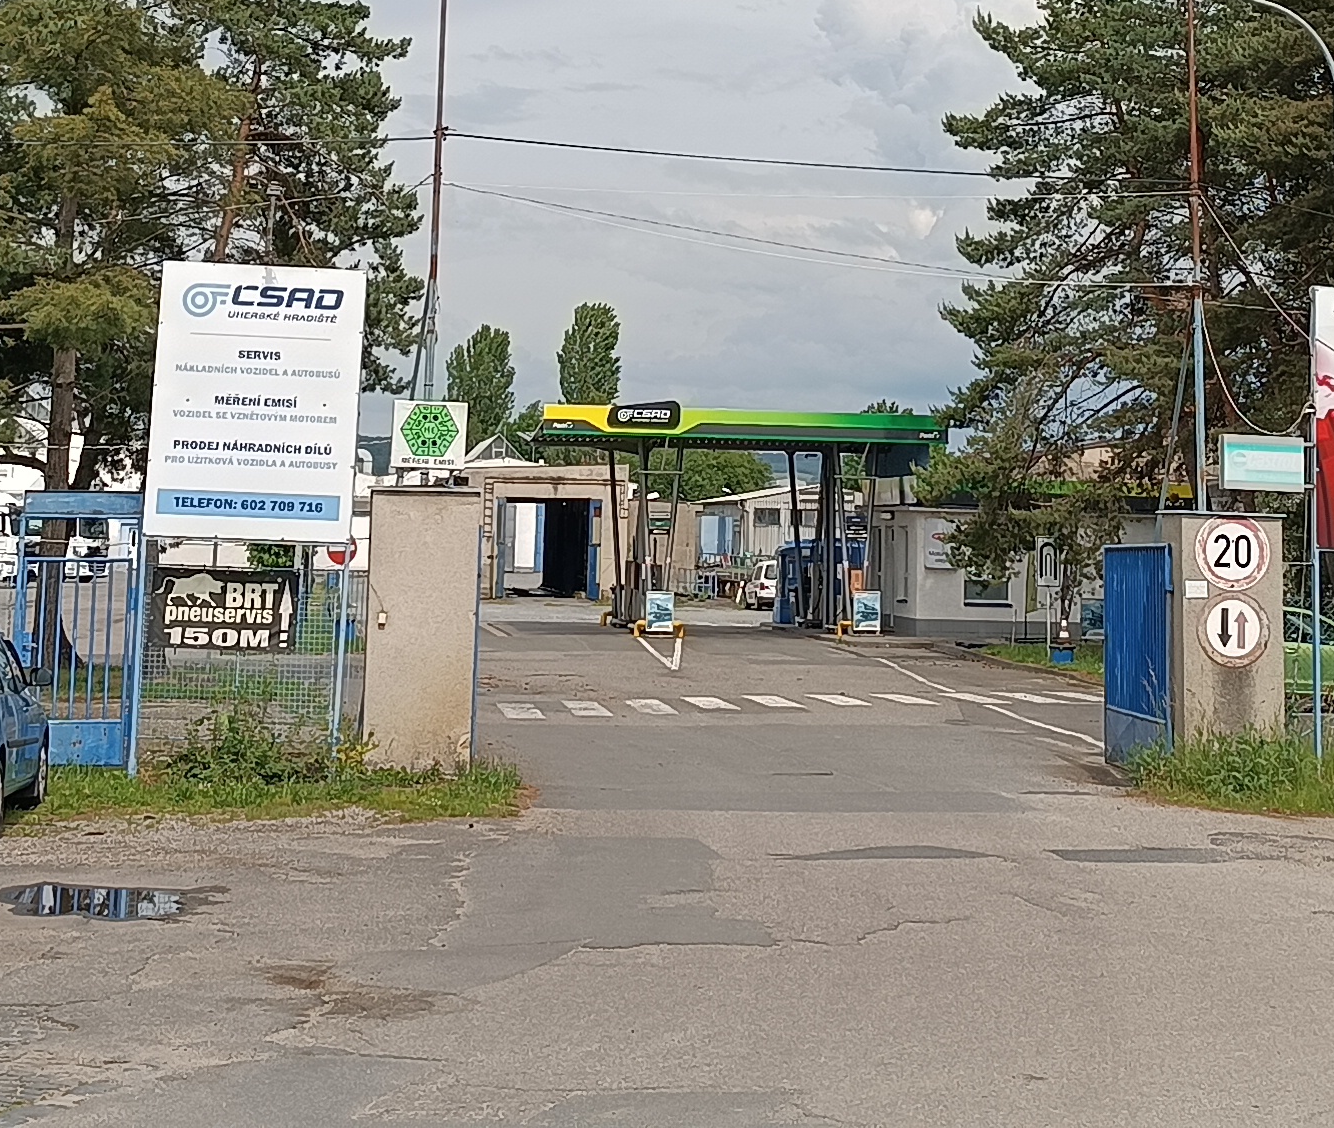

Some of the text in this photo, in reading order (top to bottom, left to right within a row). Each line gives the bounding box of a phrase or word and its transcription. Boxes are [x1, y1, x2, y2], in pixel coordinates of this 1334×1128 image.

[238, 350, 281, 361] SERVIS
[175, 362, 238, 374] NÁKLADNÍCH
[239, 366, 280, 376] VOZIDEL
[214, 393, 298, 408] MĚŘENÍ EMISÍ
[172, 409, 213, 419] VOZIDEL
[216, 411, 228, 419] SE
[289, 414, 337, 424] MOTOREM
[173, 439, 220, 451] PRODEJ
[222, 440, 301, 454] NÁHRADNÍCH
[164, 455, 185, 464] PRO
[236, 457, 277, 468] VOZIDLA
[279, 460, 286, 468] A
[288, 460, 338, 470] AUTOBUSY
[174, 496, 323, 514] TELEFON: 602 709 716
[1214, 534, 1251, 568] 20
[225, 582, 278, 609] BRT
[164, 605, 273, 625] pneuservis
[163, 627, 270, 648] 150M
